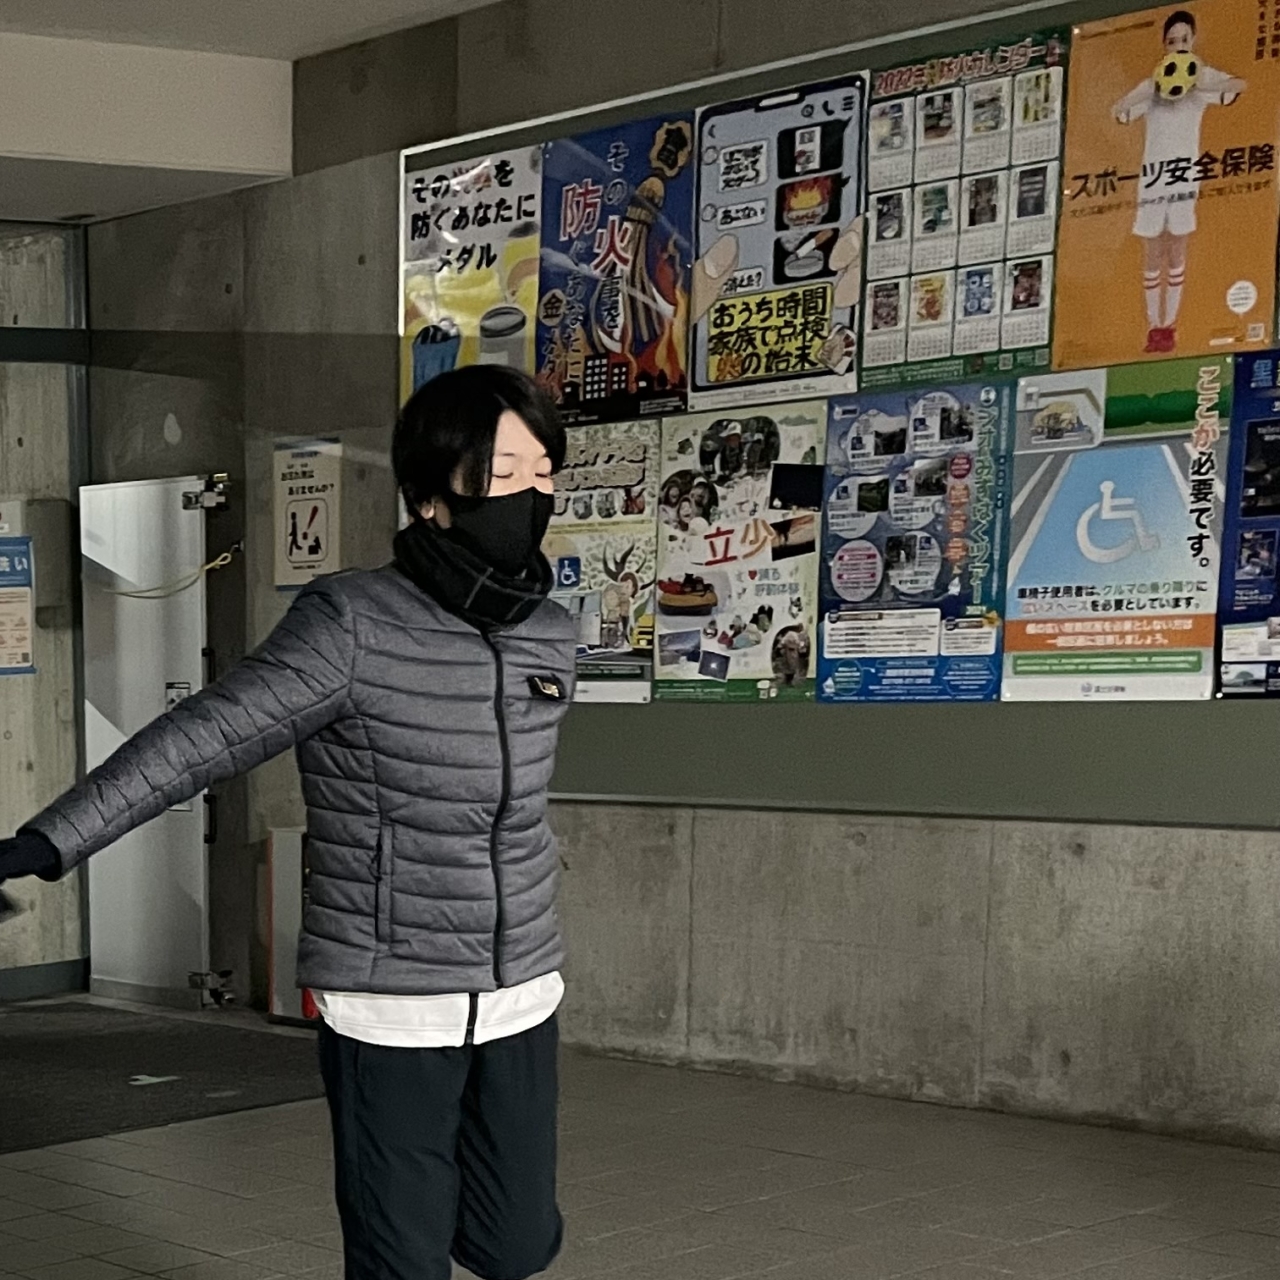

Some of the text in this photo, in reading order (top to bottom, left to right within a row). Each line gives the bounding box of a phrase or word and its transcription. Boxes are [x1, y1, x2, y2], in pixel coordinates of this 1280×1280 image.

[412, 160, 515, 203] そのを
[1070, 143, 1275, 200] スポーツ安全保険
[713, 286, 828, 329] おうち時間
[708, 316, 829, 356] 家族で点検
[715, 344, 819, 382] 火の始末
[1187, 364, 1221, 568] ここが必要です。
[703, 518, 776, 566] 立少
